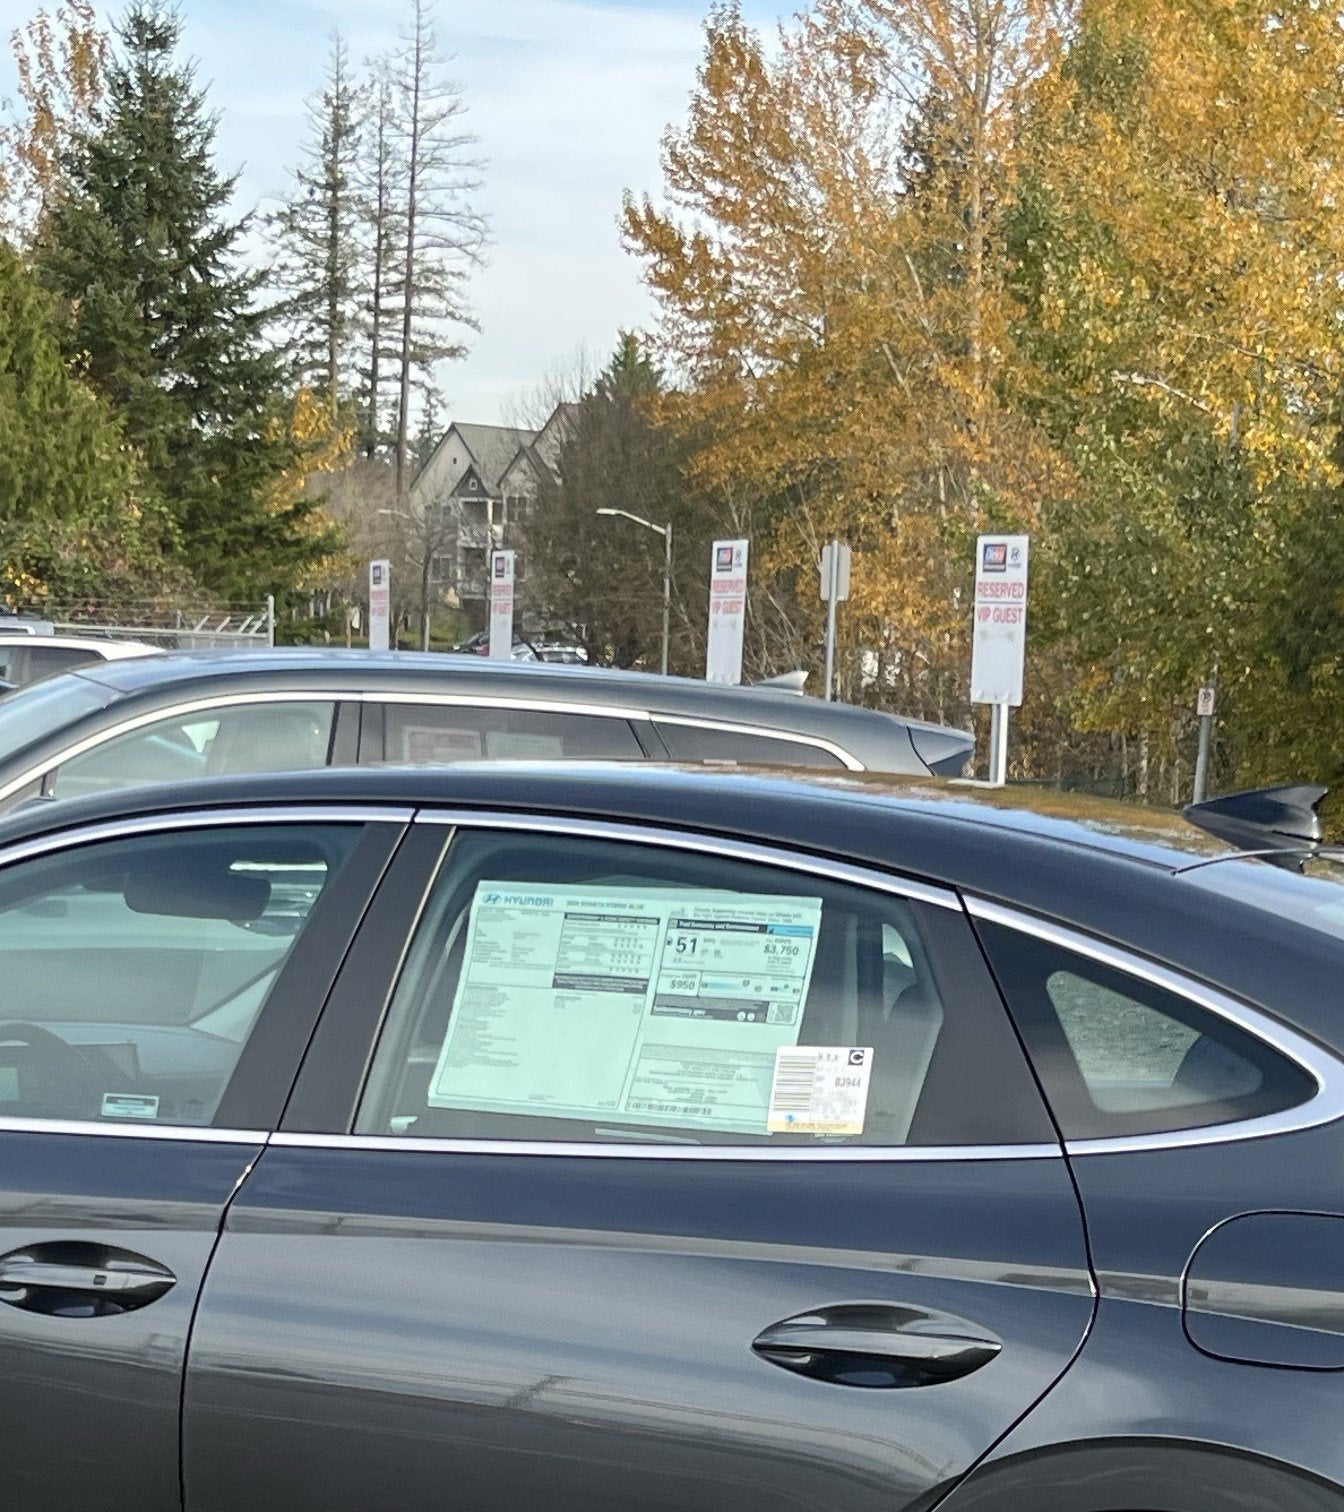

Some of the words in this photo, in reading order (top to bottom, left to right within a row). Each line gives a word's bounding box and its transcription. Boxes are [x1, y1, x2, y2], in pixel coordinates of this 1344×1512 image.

[977, 581, 1025, 598] RESERVED
[992, 606, 1023, 624] GUEST
[503, 894, 555, 907] HYUNDAI
[676, 936, 697, 953] 51
[670, 980, 696, 990] $950
